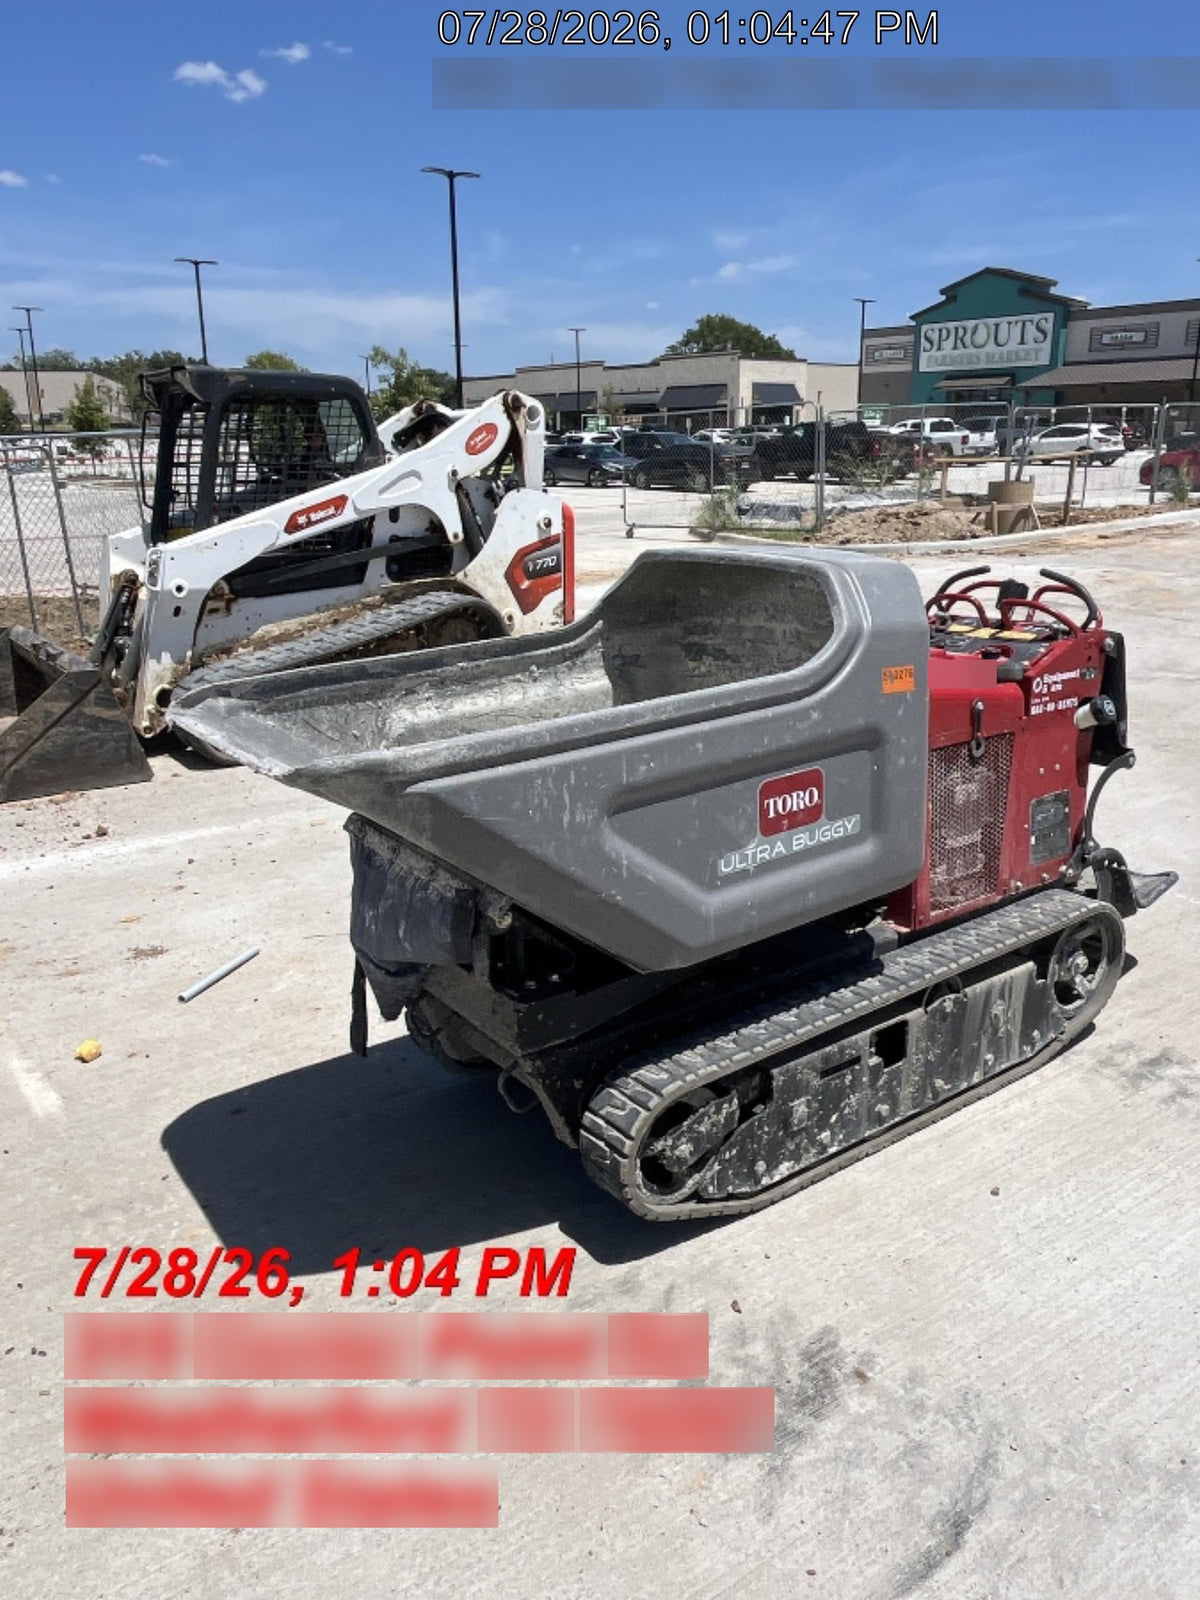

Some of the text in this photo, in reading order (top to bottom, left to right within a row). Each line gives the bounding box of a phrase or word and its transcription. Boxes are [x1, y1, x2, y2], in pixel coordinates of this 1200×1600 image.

[922, 316, 1049, 353] SPROUTS
[764, 786, 820, 819] TORO
[720, 817, 857, 873] ULTRA BUGGY
